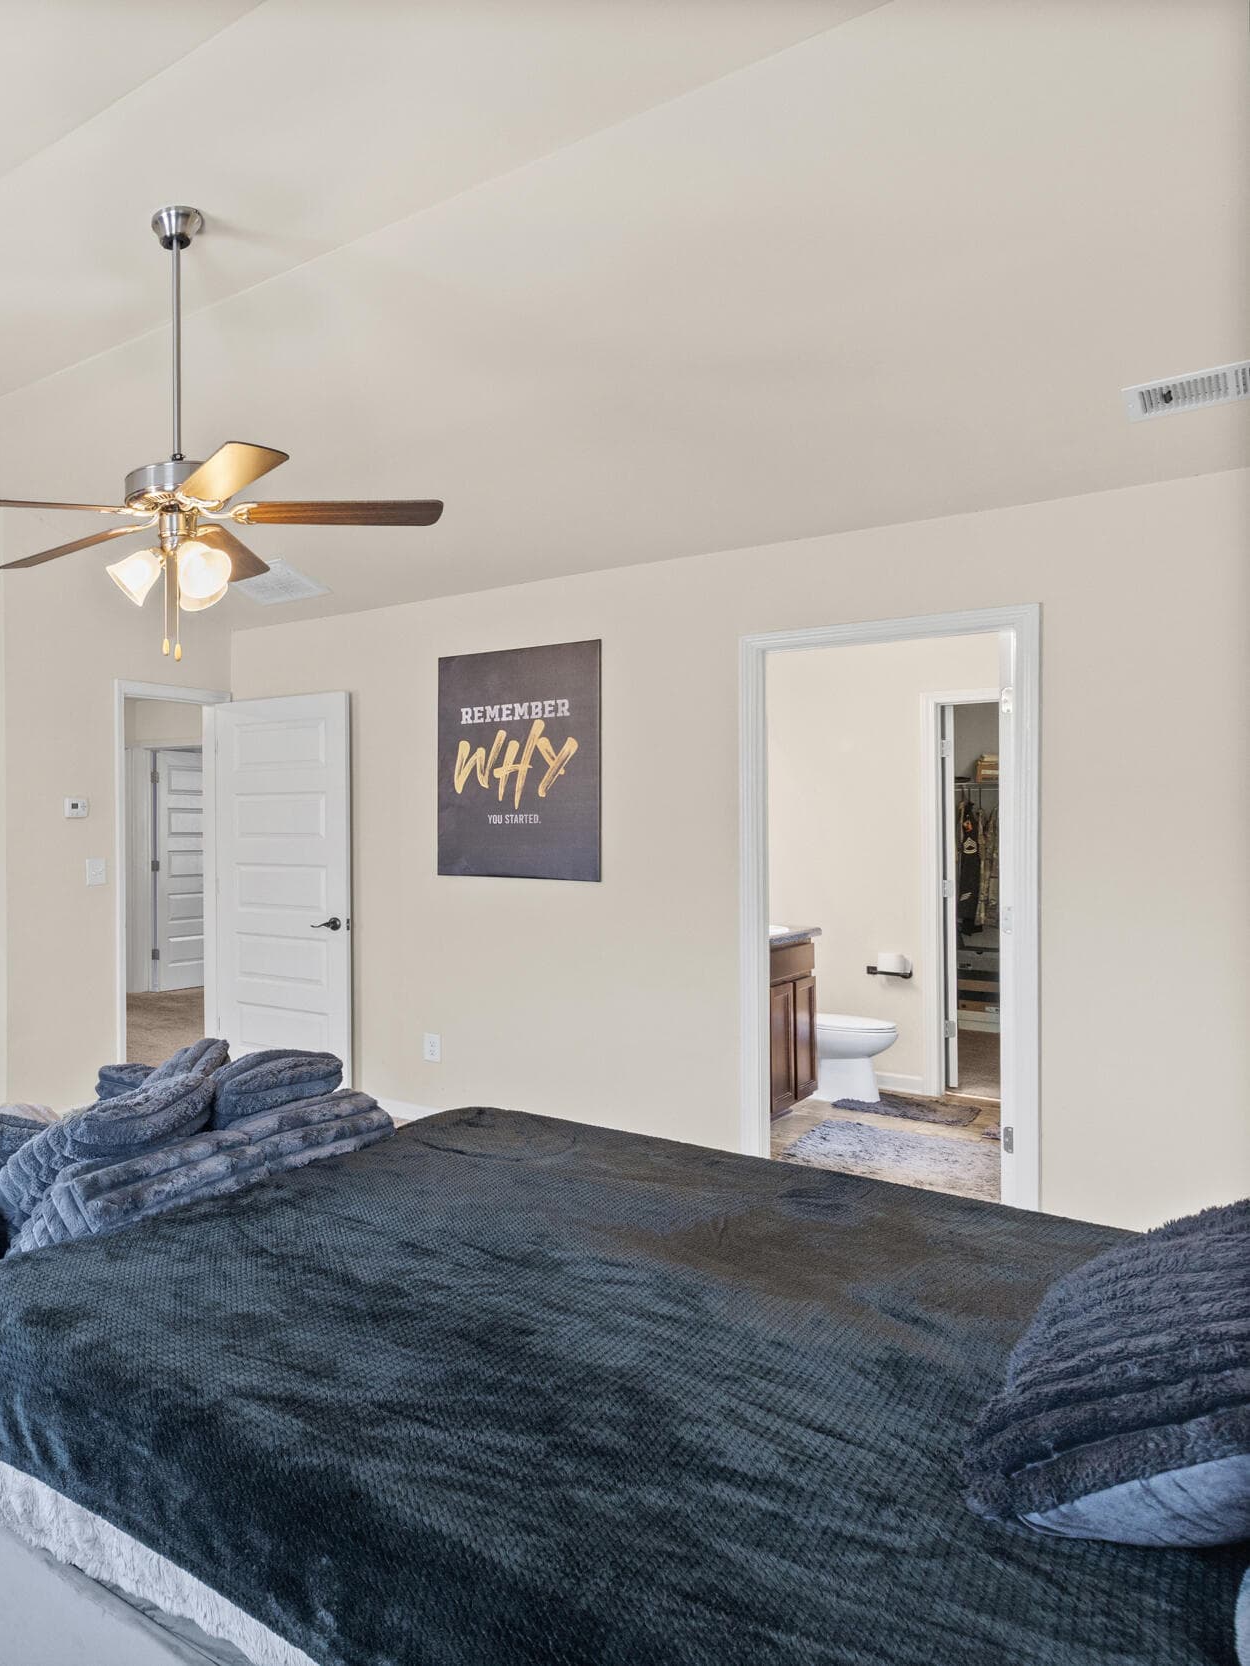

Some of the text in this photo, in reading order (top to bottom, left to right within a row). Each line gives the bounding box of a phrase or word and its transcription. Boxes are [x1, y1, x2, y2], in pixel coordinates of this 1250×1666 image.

[461, 699, 570, 724] REMEMBER
[454, 719, 578, 810] WHY
[487, 814, 542, 825] YOU STARTED.
